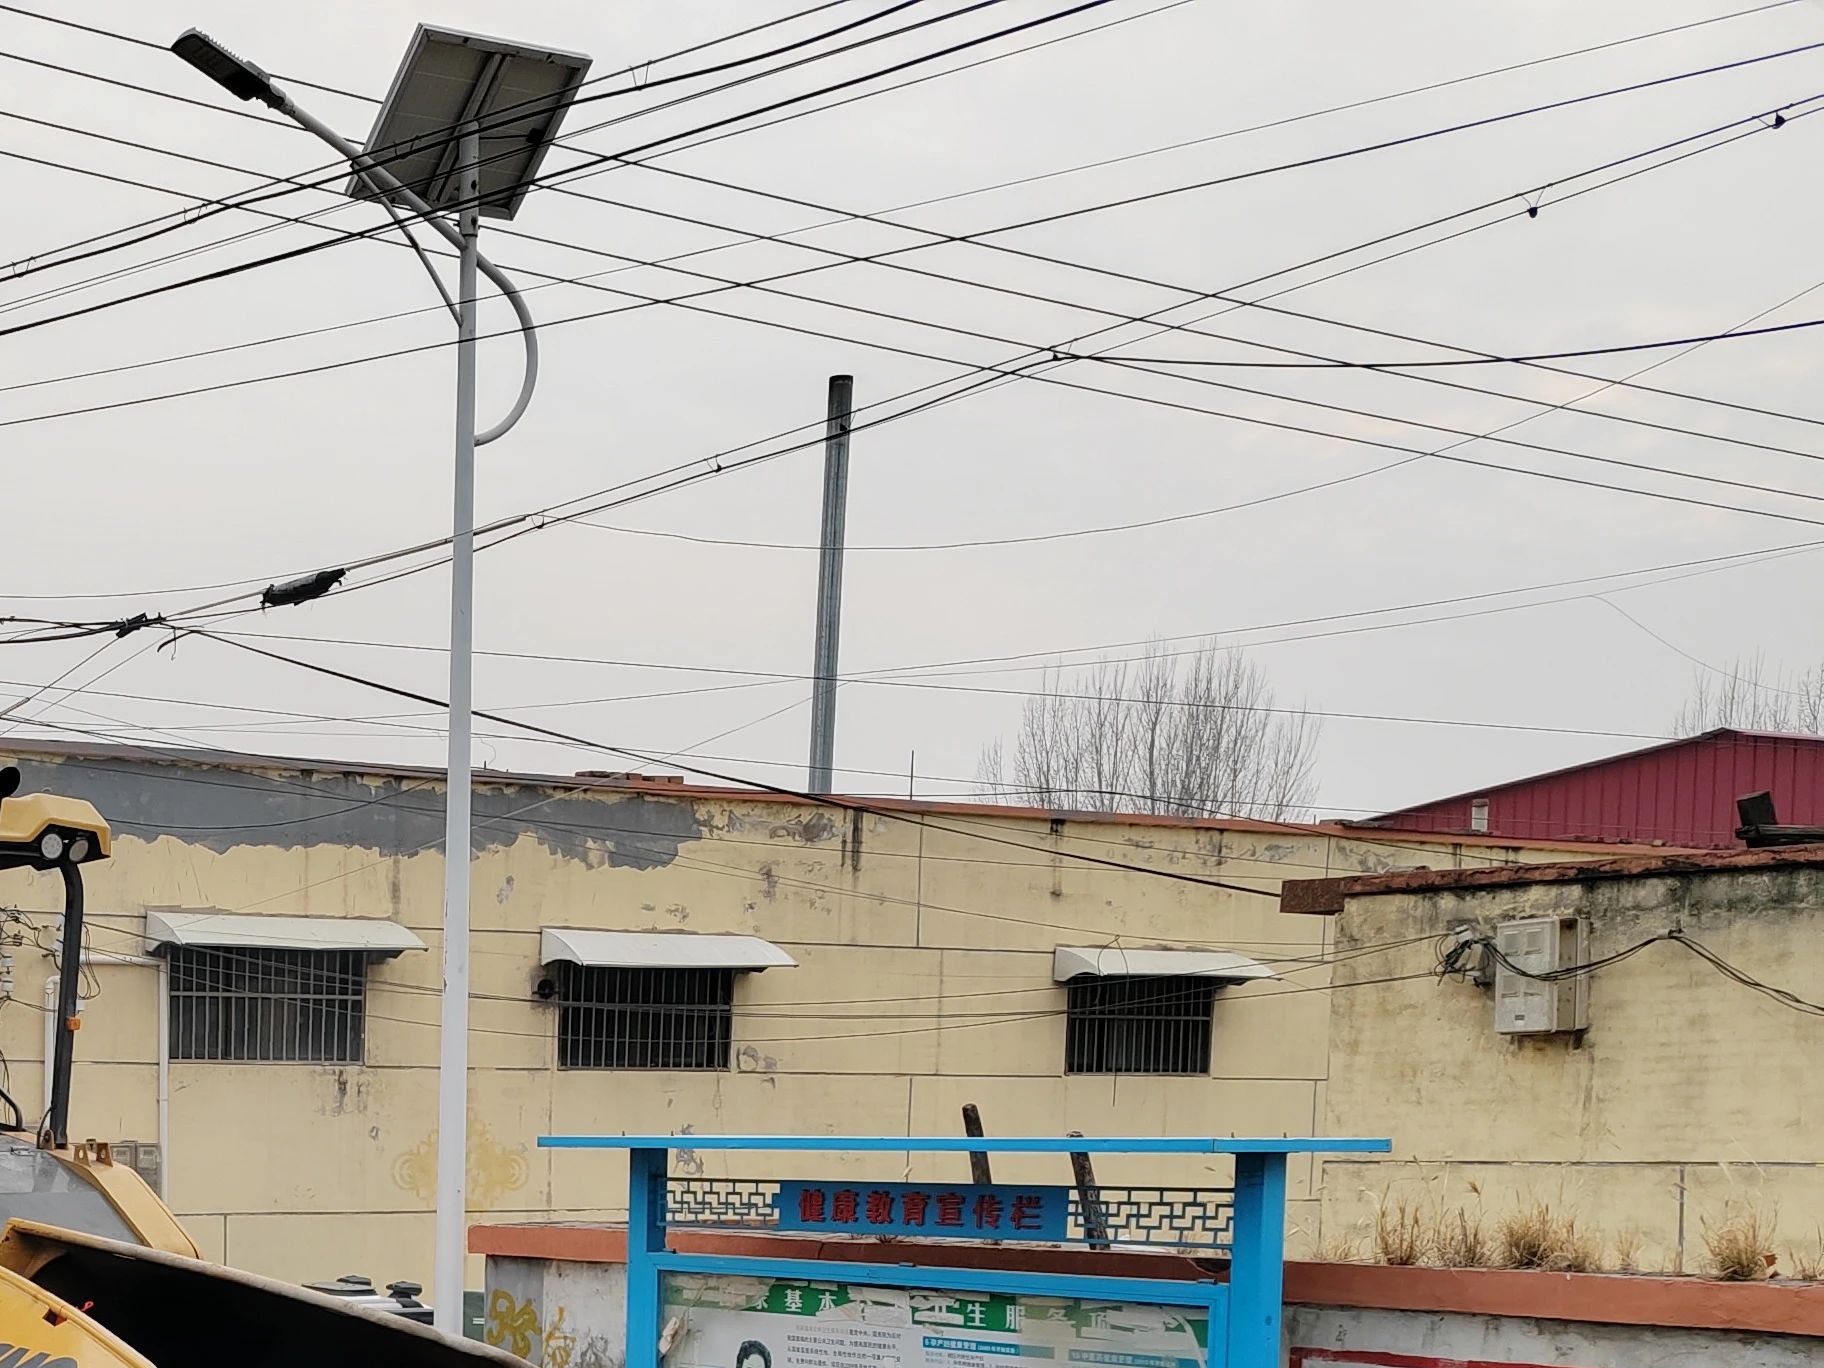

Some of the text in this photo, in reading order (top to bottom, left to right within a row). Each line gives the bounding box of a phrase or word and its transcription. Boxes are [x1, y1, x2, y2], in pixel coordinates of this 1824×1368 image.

[799, 1188, 1044, 1230] 健康教育宣传栏
